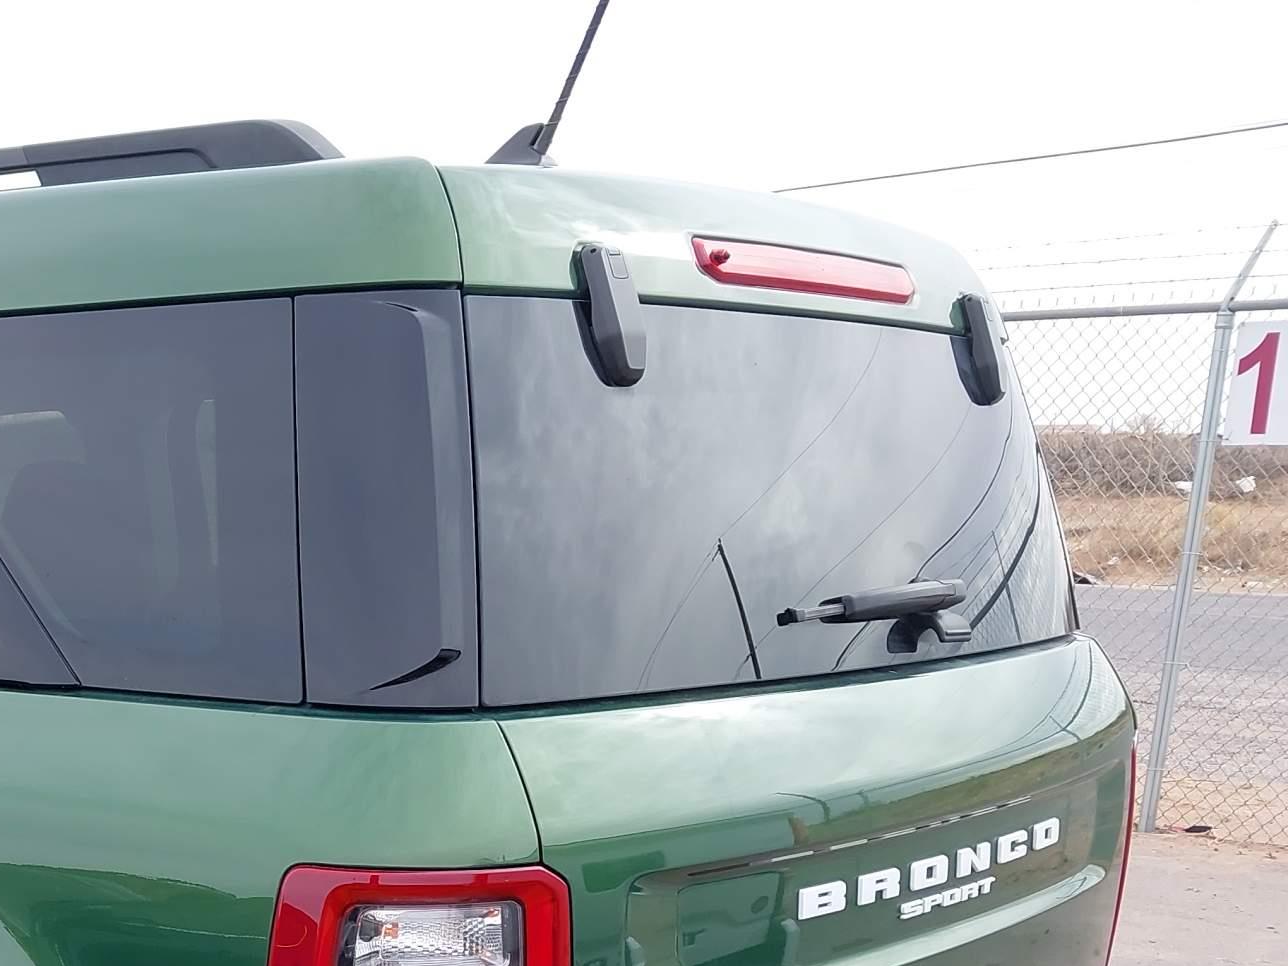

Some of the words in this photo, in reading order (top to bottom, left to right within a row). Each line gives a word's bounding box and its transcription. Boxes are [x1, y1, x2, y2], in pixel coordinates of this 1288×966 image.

[1237, 331, 1281, 435] 1
[797, 816, 1061, 921] BRONCO
[899, 876, 996, 920] SPORT
